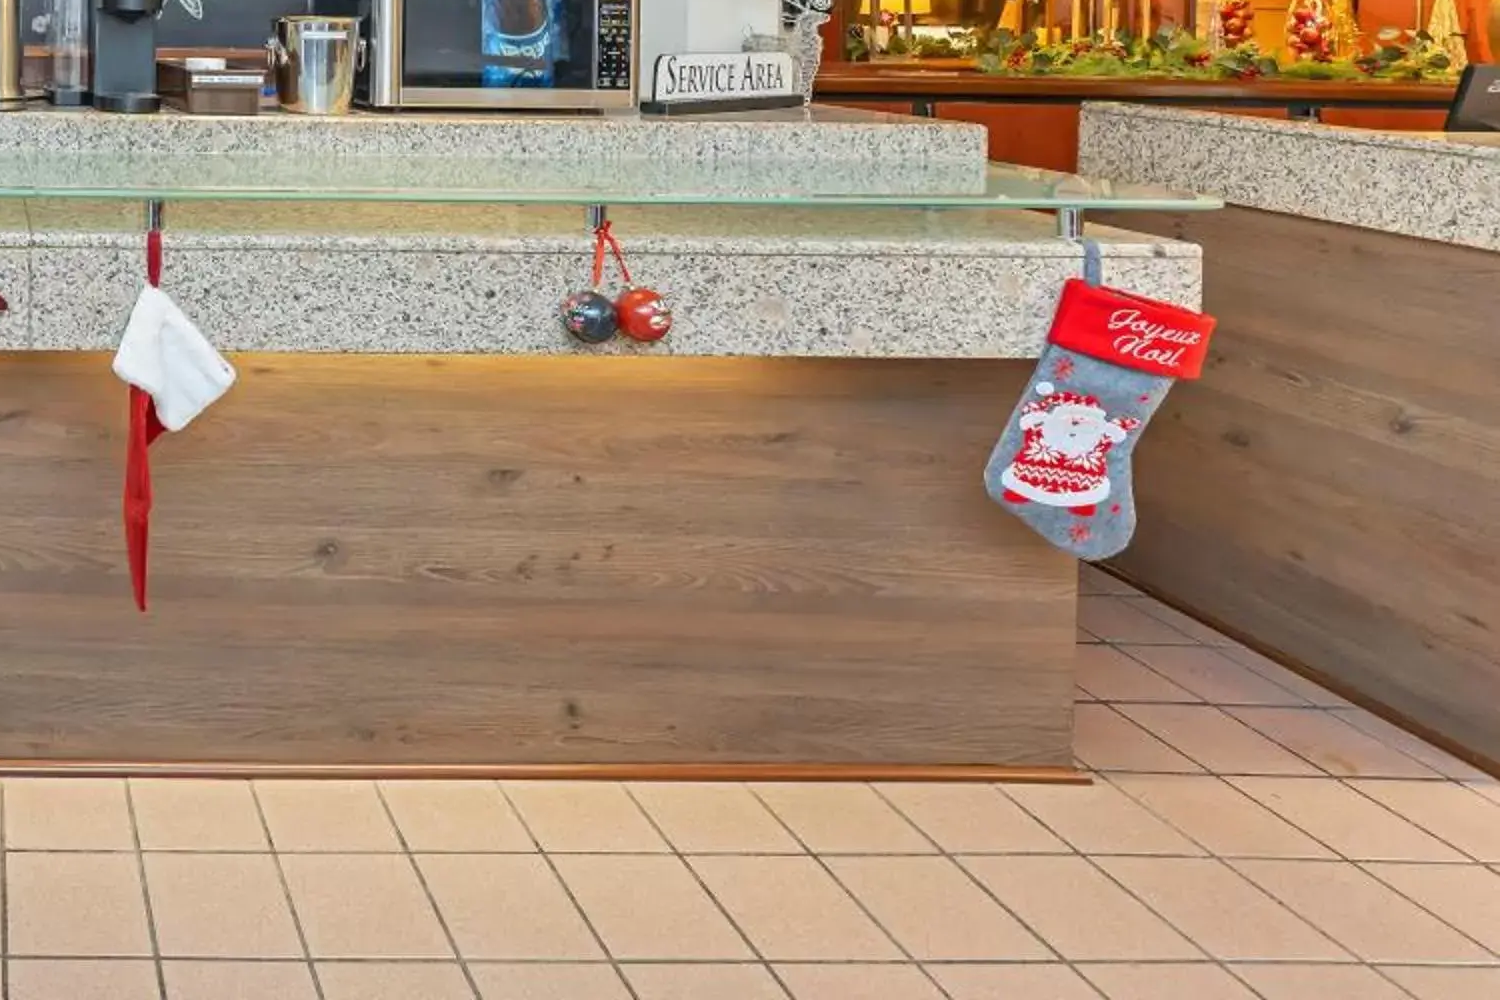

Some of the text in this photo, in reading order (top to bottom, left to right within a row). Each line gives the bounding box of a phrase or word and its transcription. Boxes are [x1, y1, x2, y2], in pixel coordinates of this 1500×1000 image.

[665, 54, 785, 95] SERVICE AREA
[1107, 308, 1202, 345] Joyeux
